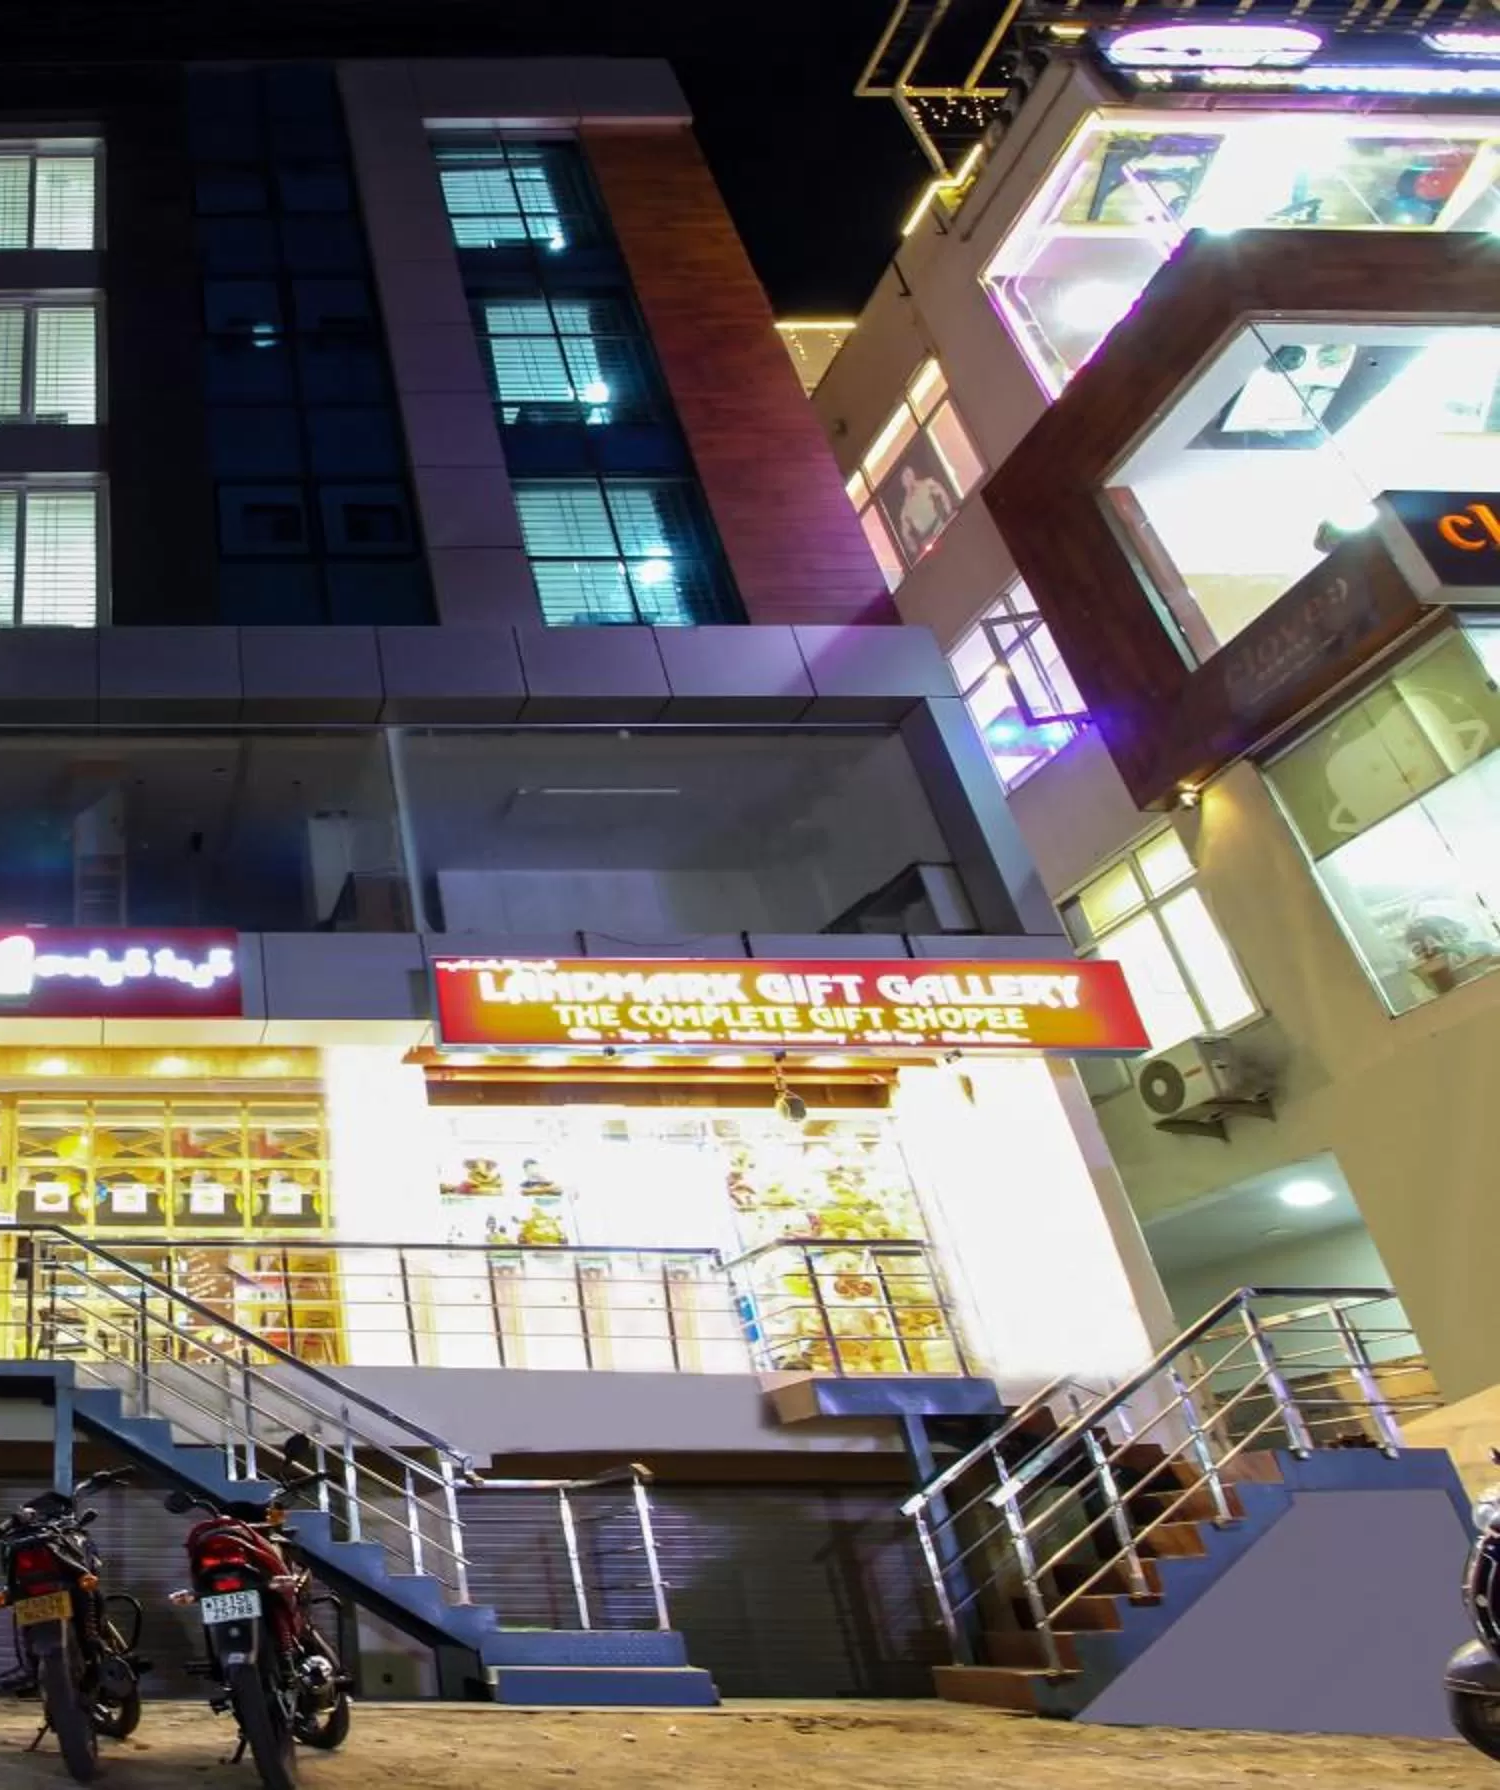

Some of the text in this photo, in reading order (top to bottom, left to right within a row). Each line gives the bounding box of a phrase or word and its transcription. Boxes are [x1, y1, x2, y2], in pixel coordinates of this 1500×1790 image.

[478, 970, 1081, 1008] LANDMARK GIFT GALLERY
[552, 1004, 1029, 1030] THE COMPLETE GIFT SHOPEE
